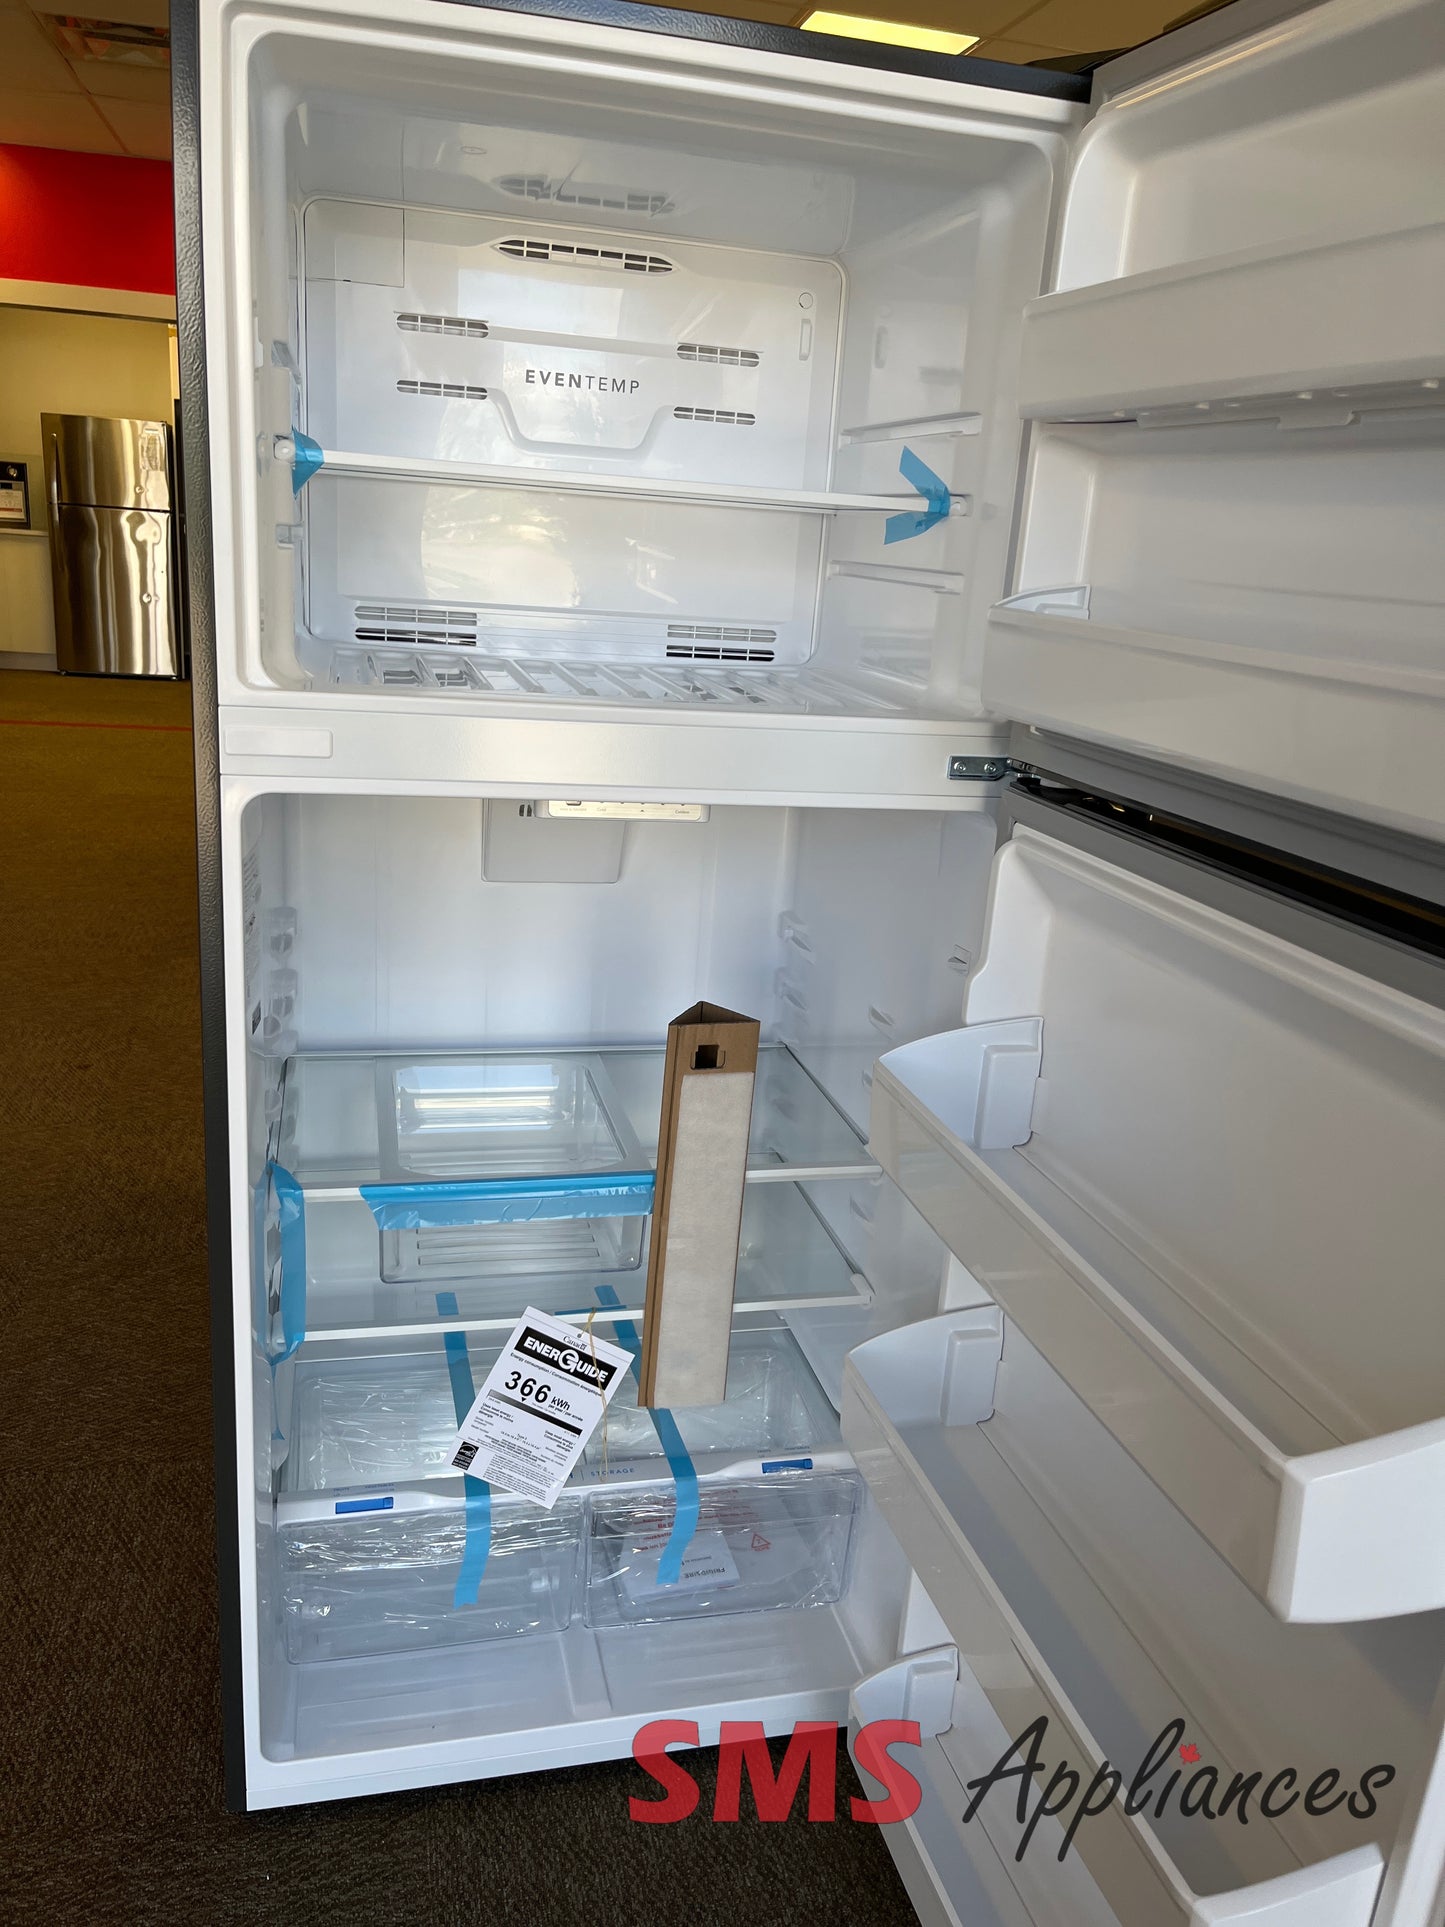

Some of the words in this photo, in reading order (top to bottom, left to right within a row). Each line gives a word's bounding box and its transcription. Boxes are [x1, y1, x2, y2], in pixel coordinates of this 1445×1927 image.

[525, 369, 640, 394] EVENTEMP
[524, 1336, 609, 1382] ENERGUIDE
[505, 1371, 551, 1403] 366
[551, 1396, 570, 1410] kWh
[591, 1468, 634, 1476] STORAGE
